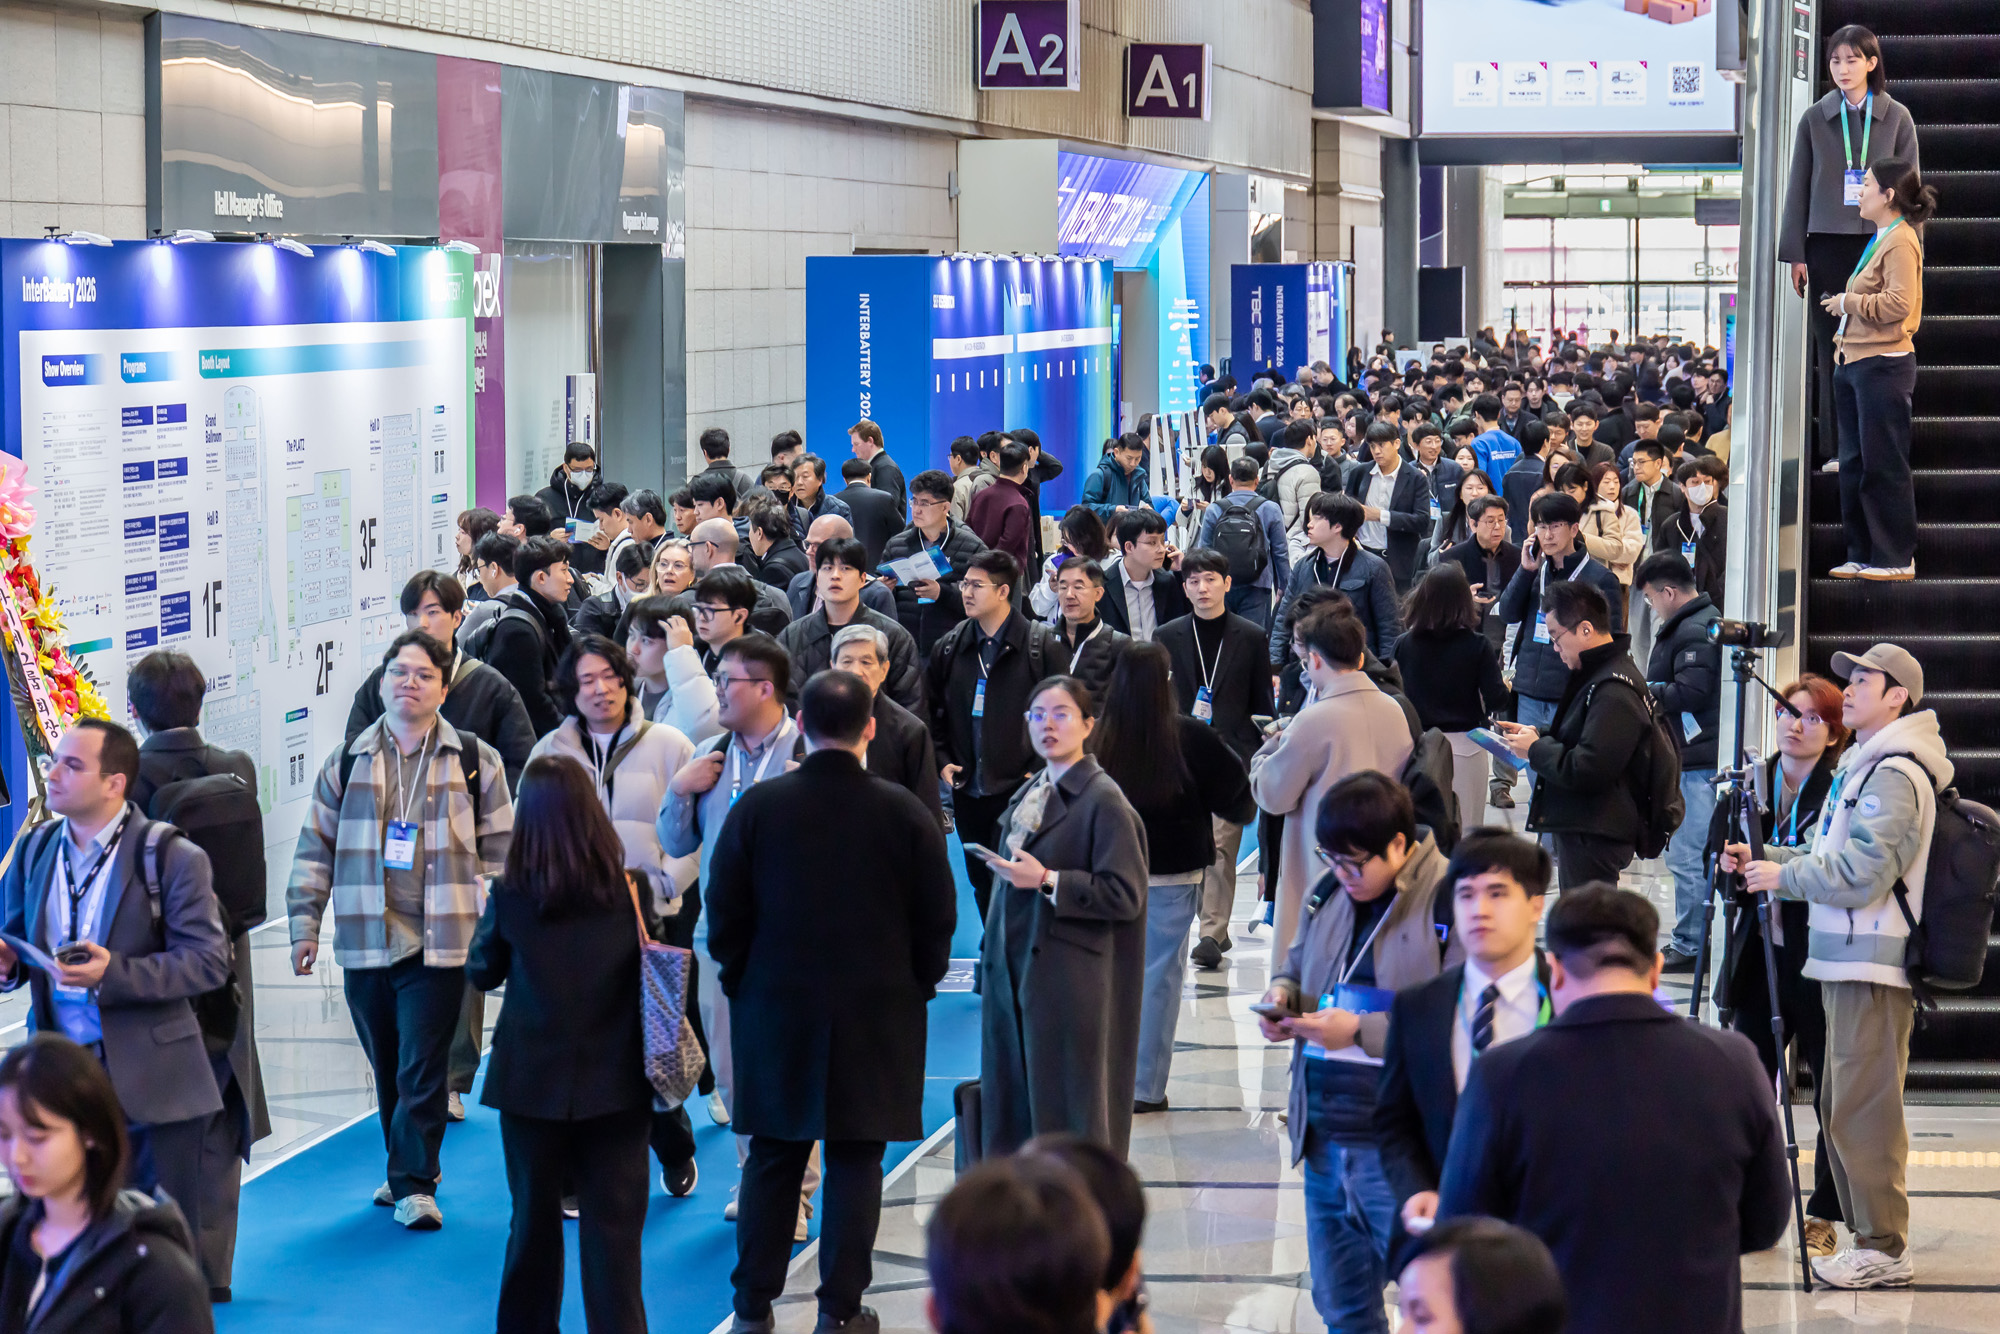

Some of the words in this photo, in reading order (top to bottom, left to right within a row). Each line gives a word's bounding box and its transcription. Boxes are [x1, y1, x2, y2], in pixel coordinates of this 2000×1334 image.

[985, 13, 1064, 76] A2
[1135, 54, 1196, 108] A1
[215, 190, 229, 216] Hall
[229, 191, 264, 223] Manager's
[264, 193, 283, 218] Office
[1695, 261, 1730, 276] East
[22, 275, 75, 309] InterBattery
[76, 276, 97, 302] 2026
[1251, 285, 1262, 325] TBC
[1276, 285, 1284, 344] INTERBATTERY
[859, 292, 871, 388] INTERBATTERY
[1254, 327, 1262, 362] 2026
[1276, 345, 1284, 368] 2026
[44, 361, 59, 378] Show
[60, 359, 85, 377] Overview
[123, 359, 147, 378] Programs
[201, 355, 215, 370] Booth
[215, 355, 230, 373] Layout
[205, 413, 217, 427] Grand
[286, 439, 294, 452] The
[206, 510, 215, 526] Hall
[359, 517, 377, 571] 3F
[202, 580, 222, 639] 1F
[315, 640, 334, 696] 2F
